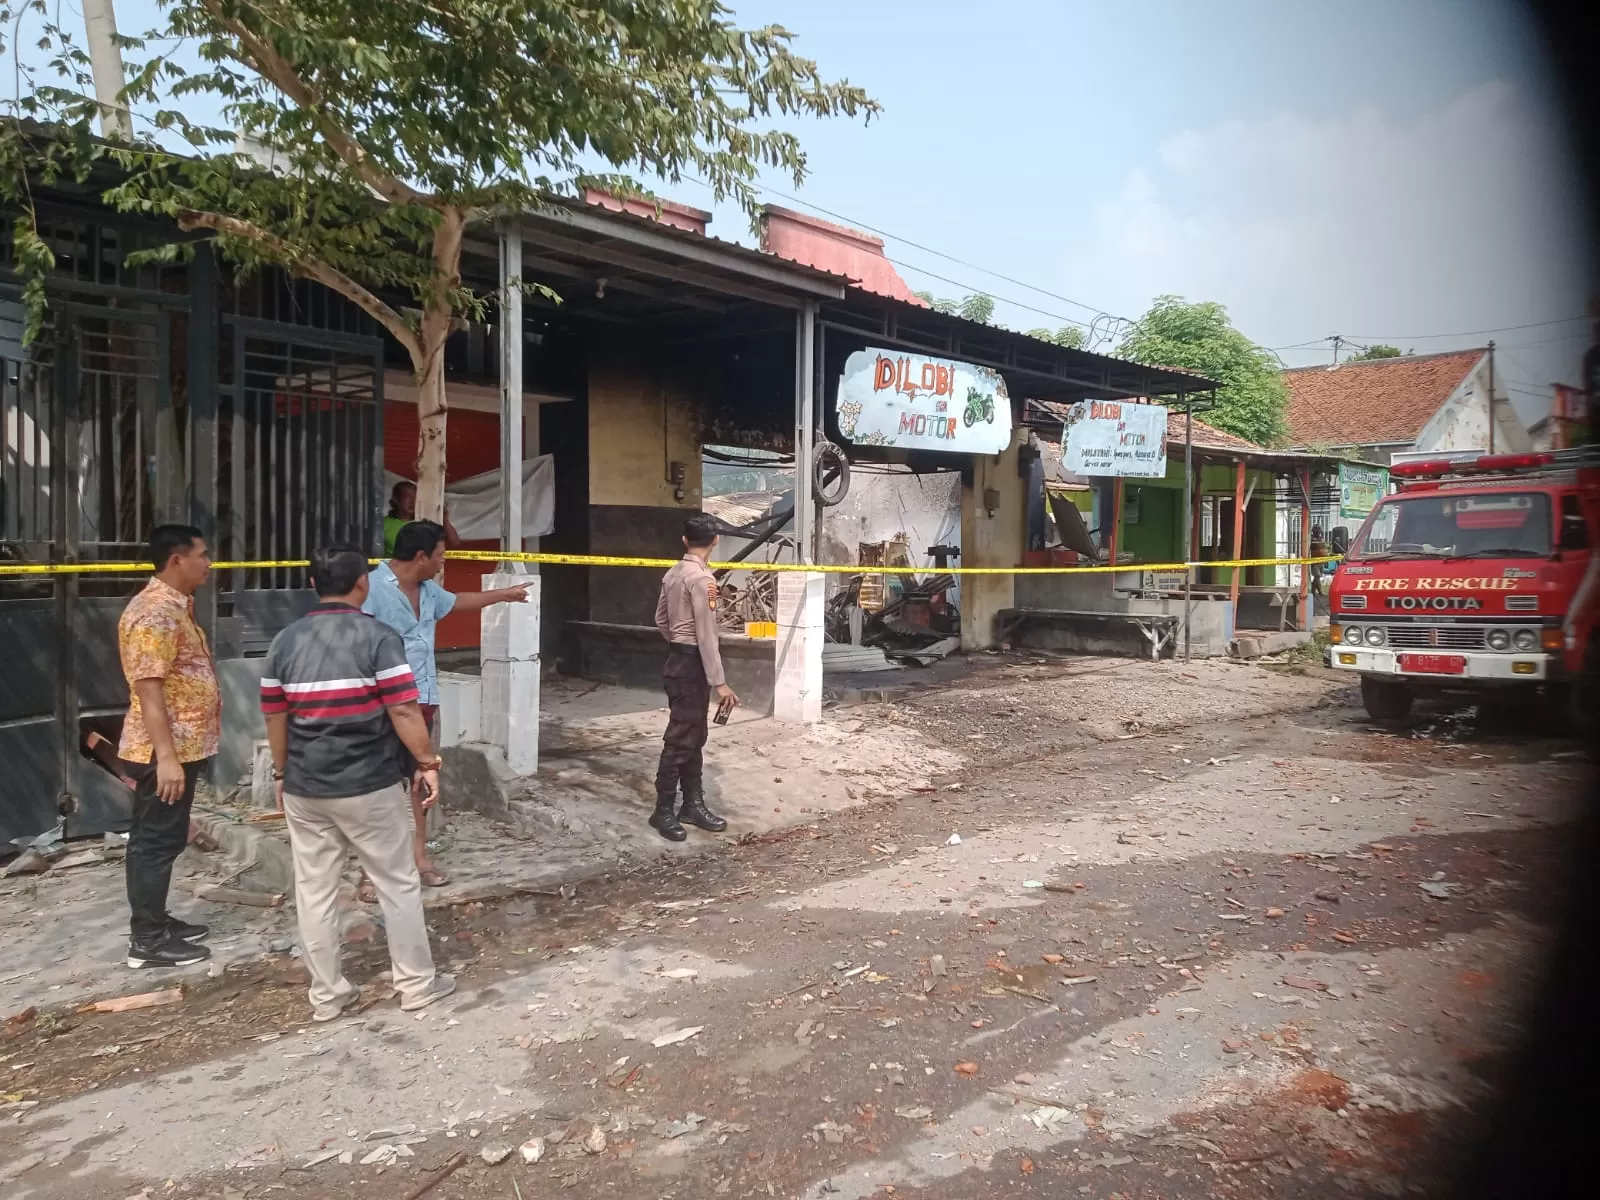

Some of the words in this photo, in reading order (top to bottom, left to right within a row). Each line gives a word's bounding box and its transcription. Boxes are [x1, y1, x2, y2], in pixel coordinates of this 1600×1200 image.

[873, 352, 956, 401] DILOBI
[898, 412, 957, 439] MOTOR
[1353, 578, 1409, 591] FIRE
[1416, 577, 1520, 591] RESCUE
[1388, 596, 1481, 610] TOYOTA
